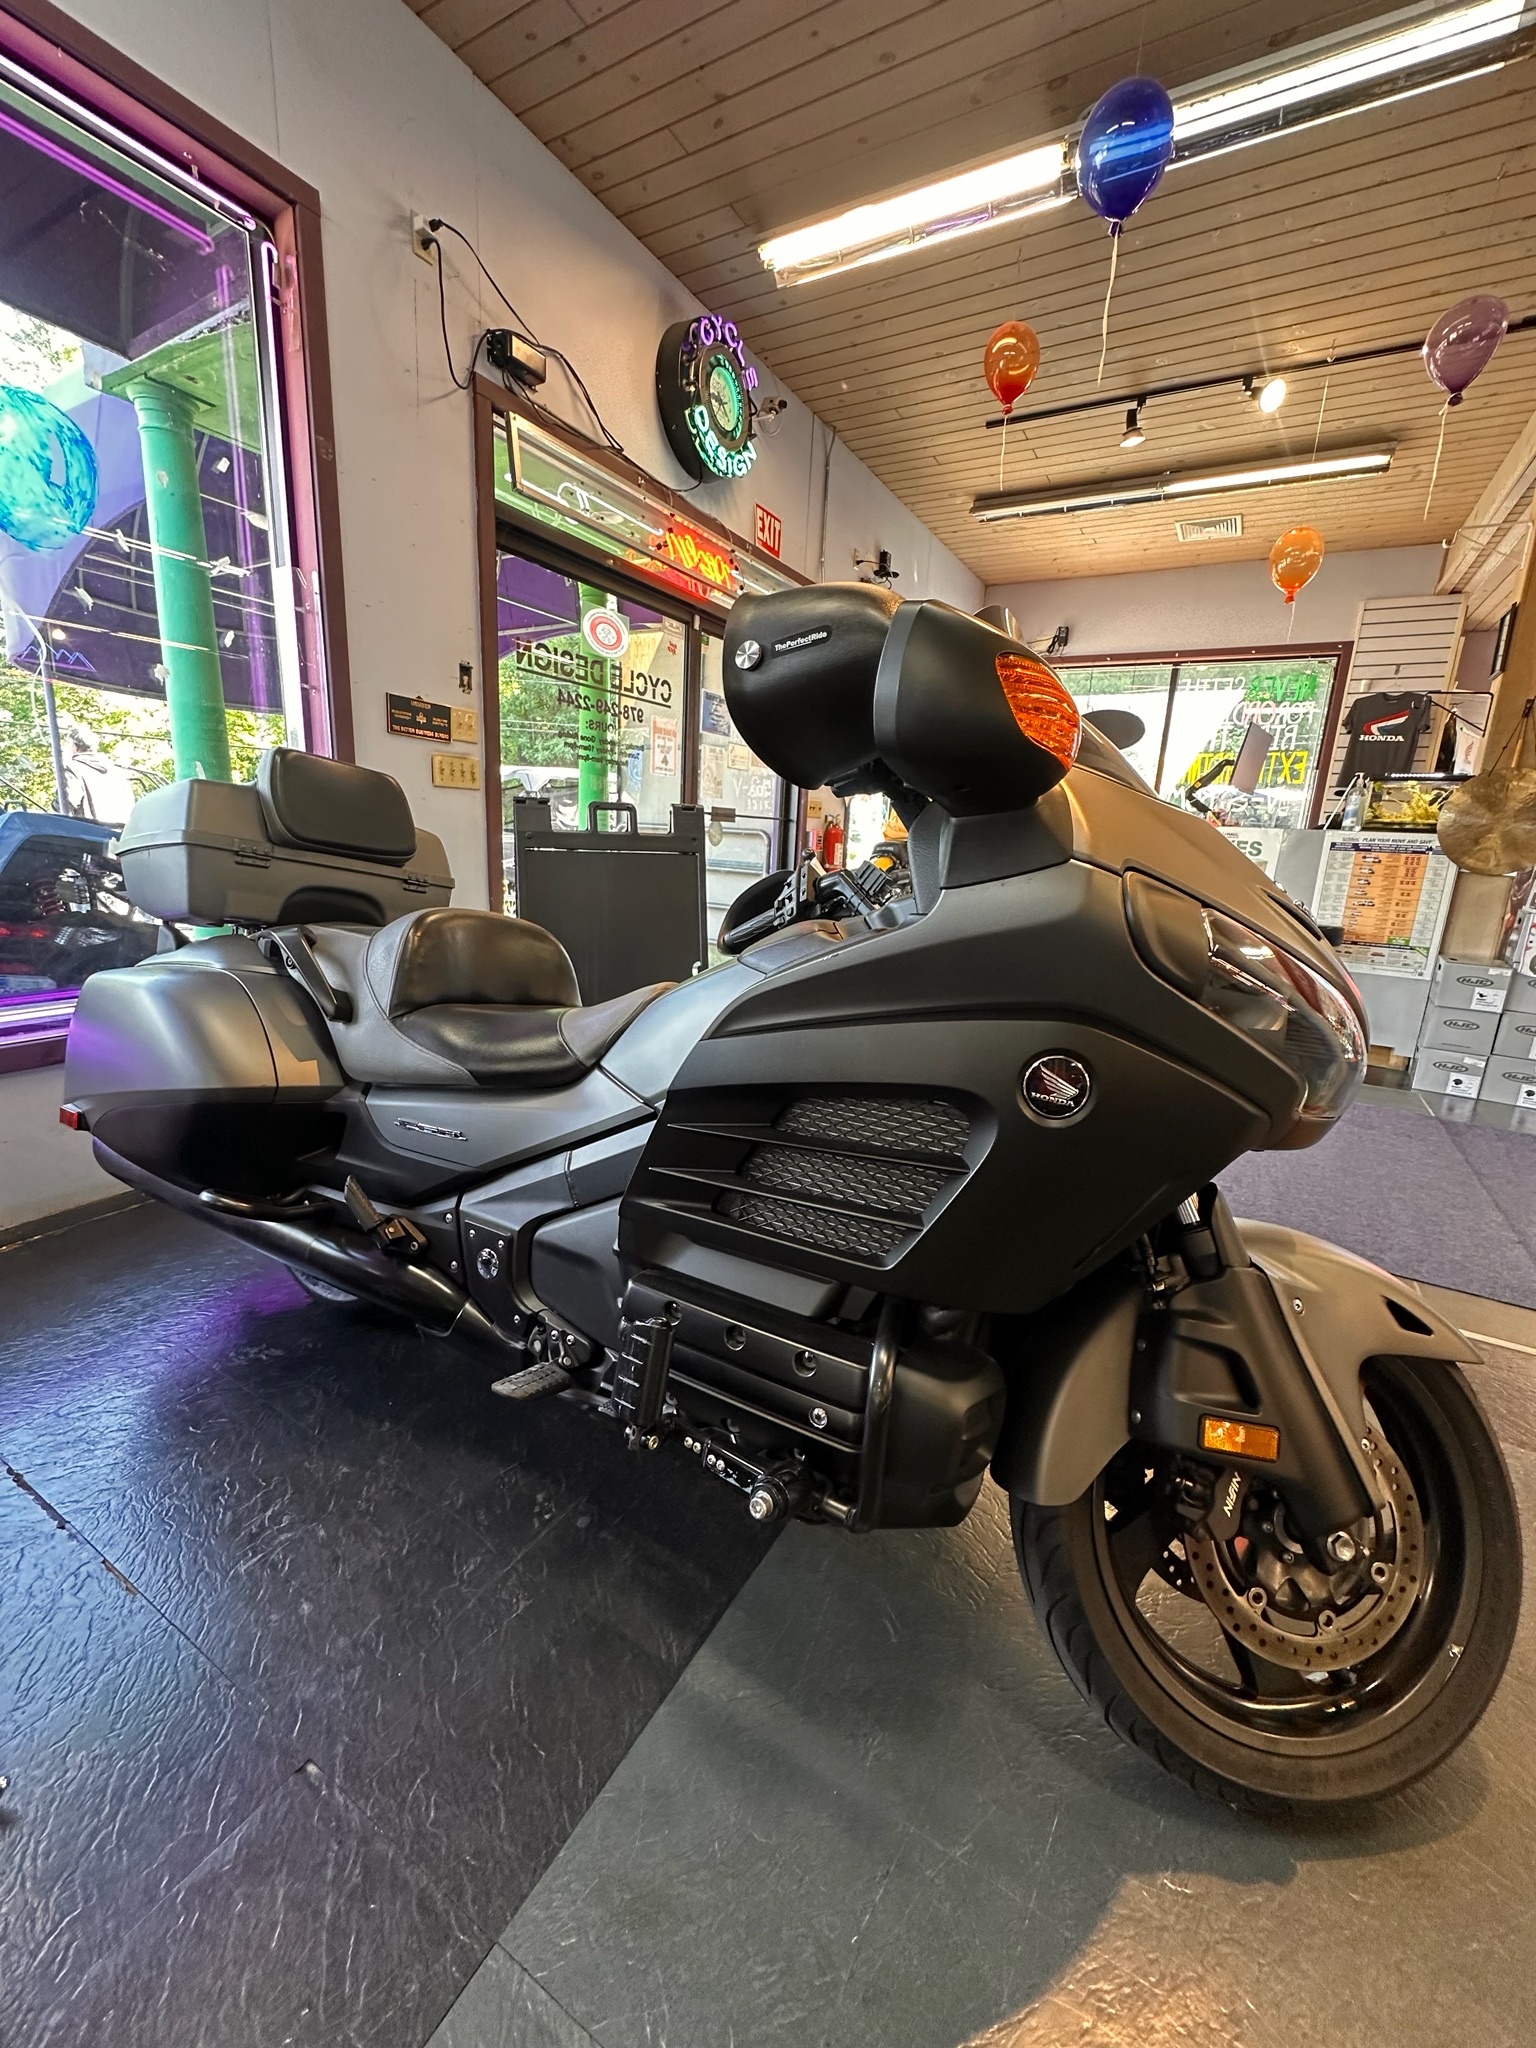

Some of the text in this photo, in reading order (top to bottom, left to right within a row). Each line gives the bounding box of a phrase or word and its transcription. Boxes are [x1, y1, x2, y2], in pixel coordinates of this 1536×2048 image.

[700, 314, 759, 391] CYCLE
[694, 405, 757, 477] DESIGN
[757, 506, 781, 552] EXIT
[1359, 734, 1405, 742] HONDA
[1031, 1091, 1076, 1107] HONDA
